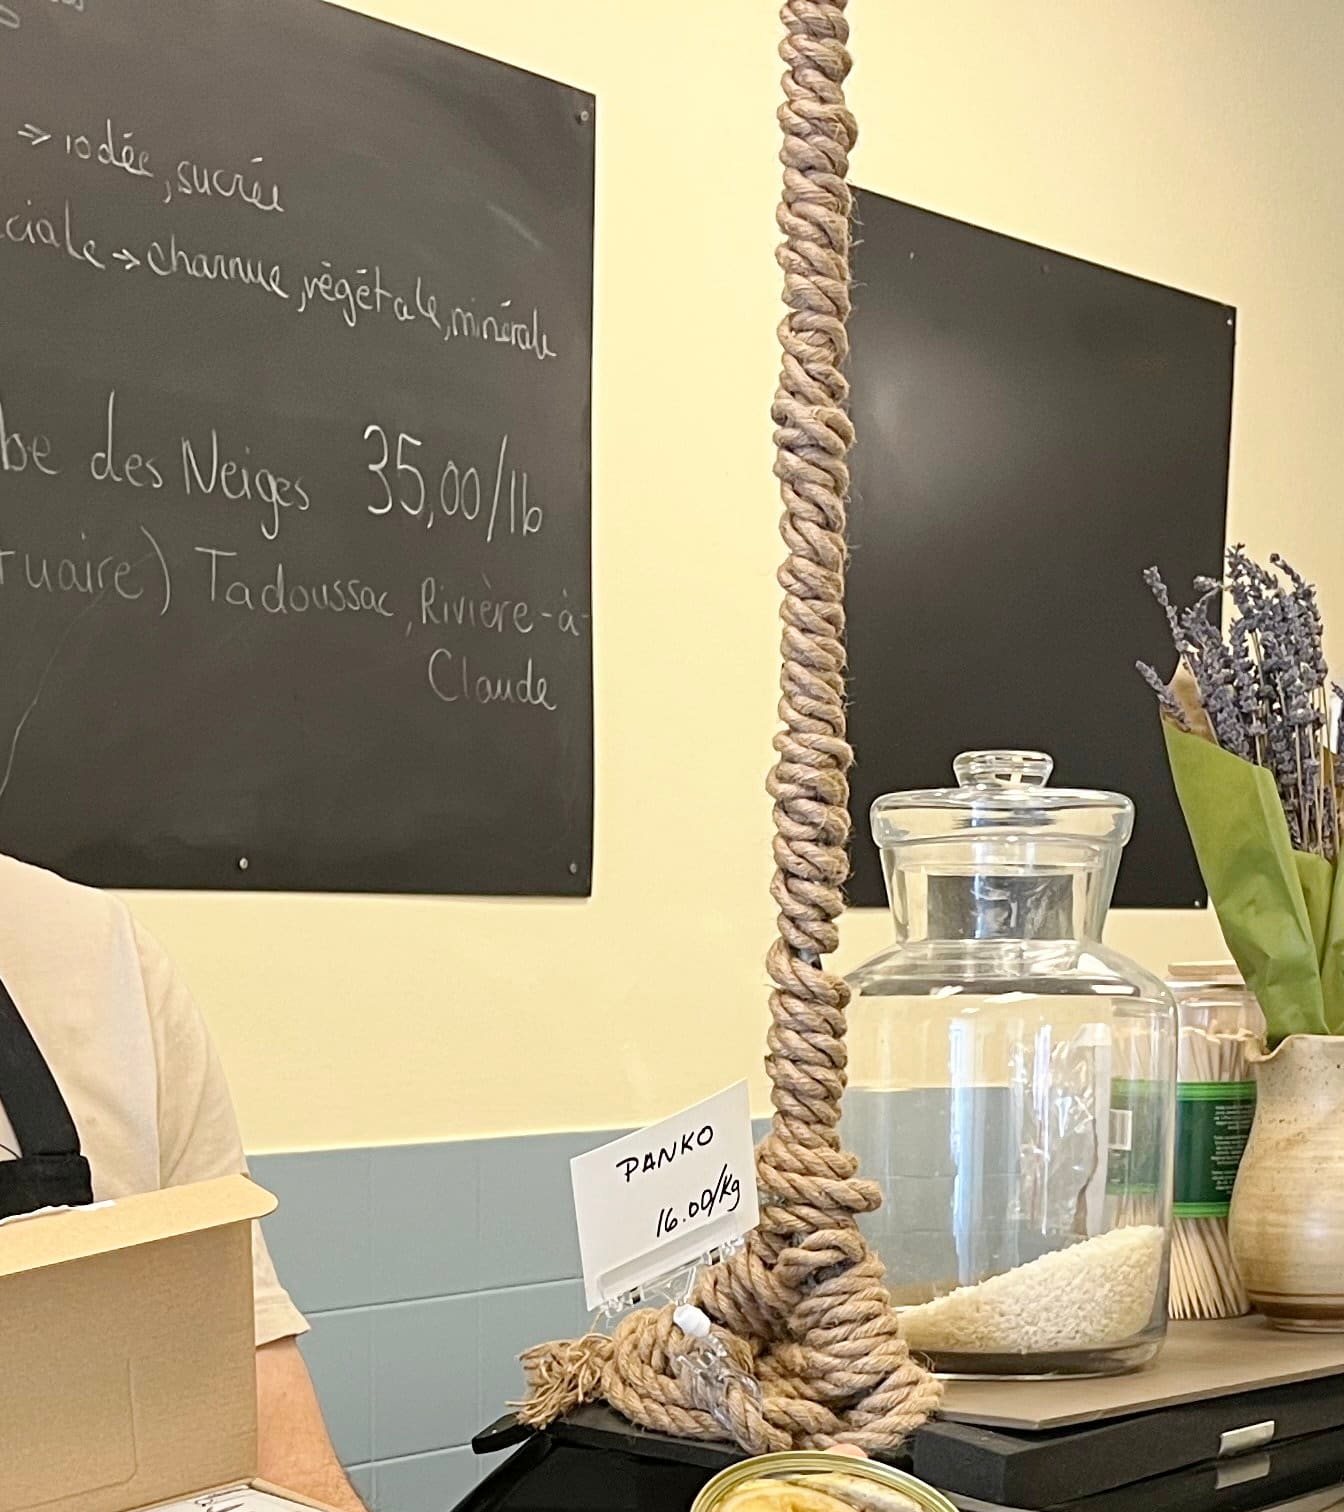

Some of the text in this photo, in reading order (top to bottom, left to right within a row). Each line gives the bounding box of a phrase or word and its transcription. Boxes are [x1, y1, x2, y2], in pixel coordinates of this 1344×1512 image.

[90, 390, 164, 490] des
[181, 429, 310, 540] Neiges
[427, 649, 557, 711] Claude
[616, 1125, 714, 1183] PANKO
